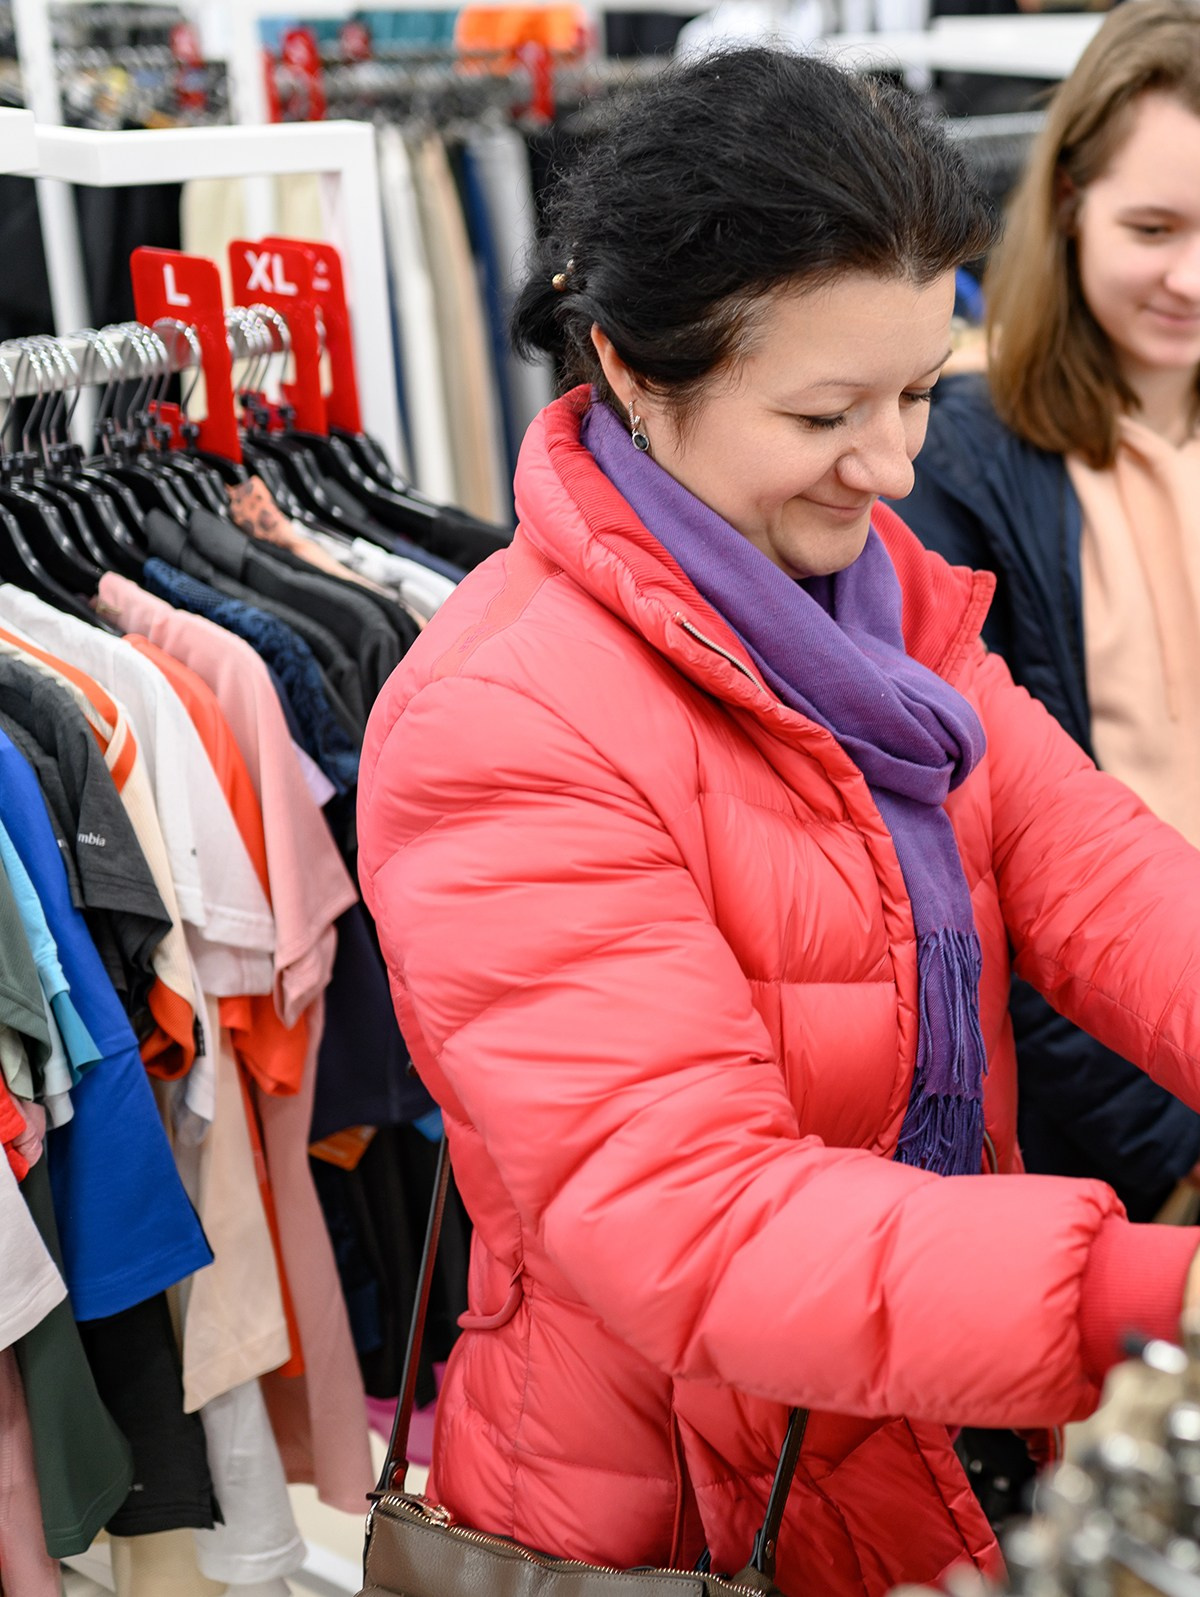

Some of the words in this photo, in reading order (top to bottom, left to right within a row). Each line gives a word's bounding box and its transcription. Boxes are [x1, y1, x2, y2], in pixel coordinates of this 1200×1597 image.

[163, 264, 191, 307] L
[244, 250, 298, 296] XL
[78, 832, 106, 847] mbia
